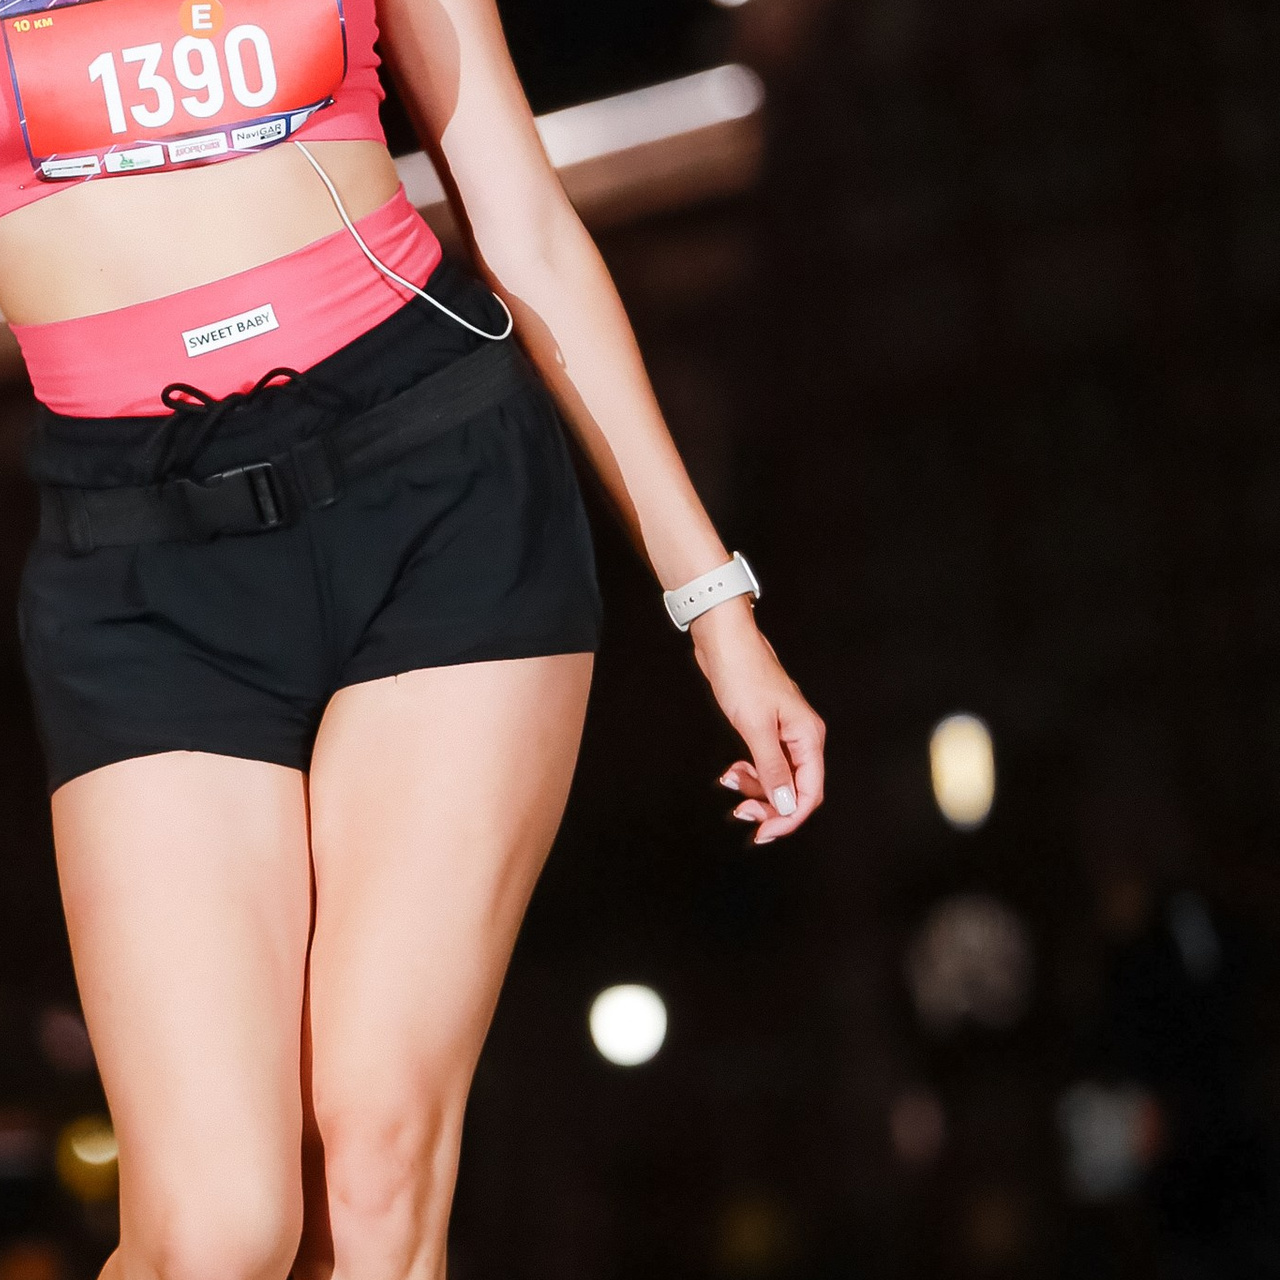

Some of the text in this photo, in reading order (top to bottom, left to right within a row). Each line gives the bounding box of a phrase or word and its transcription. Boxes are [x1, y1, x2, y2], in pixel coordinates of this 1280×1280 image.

[13, 19, 31, 33] 10
[191, 4, 213, 30] E
[87, 24, 278, 135] 1390
[236, 123, 282, 141] NaviGAR
[188, 312, 270, 349] SWEET BABY
